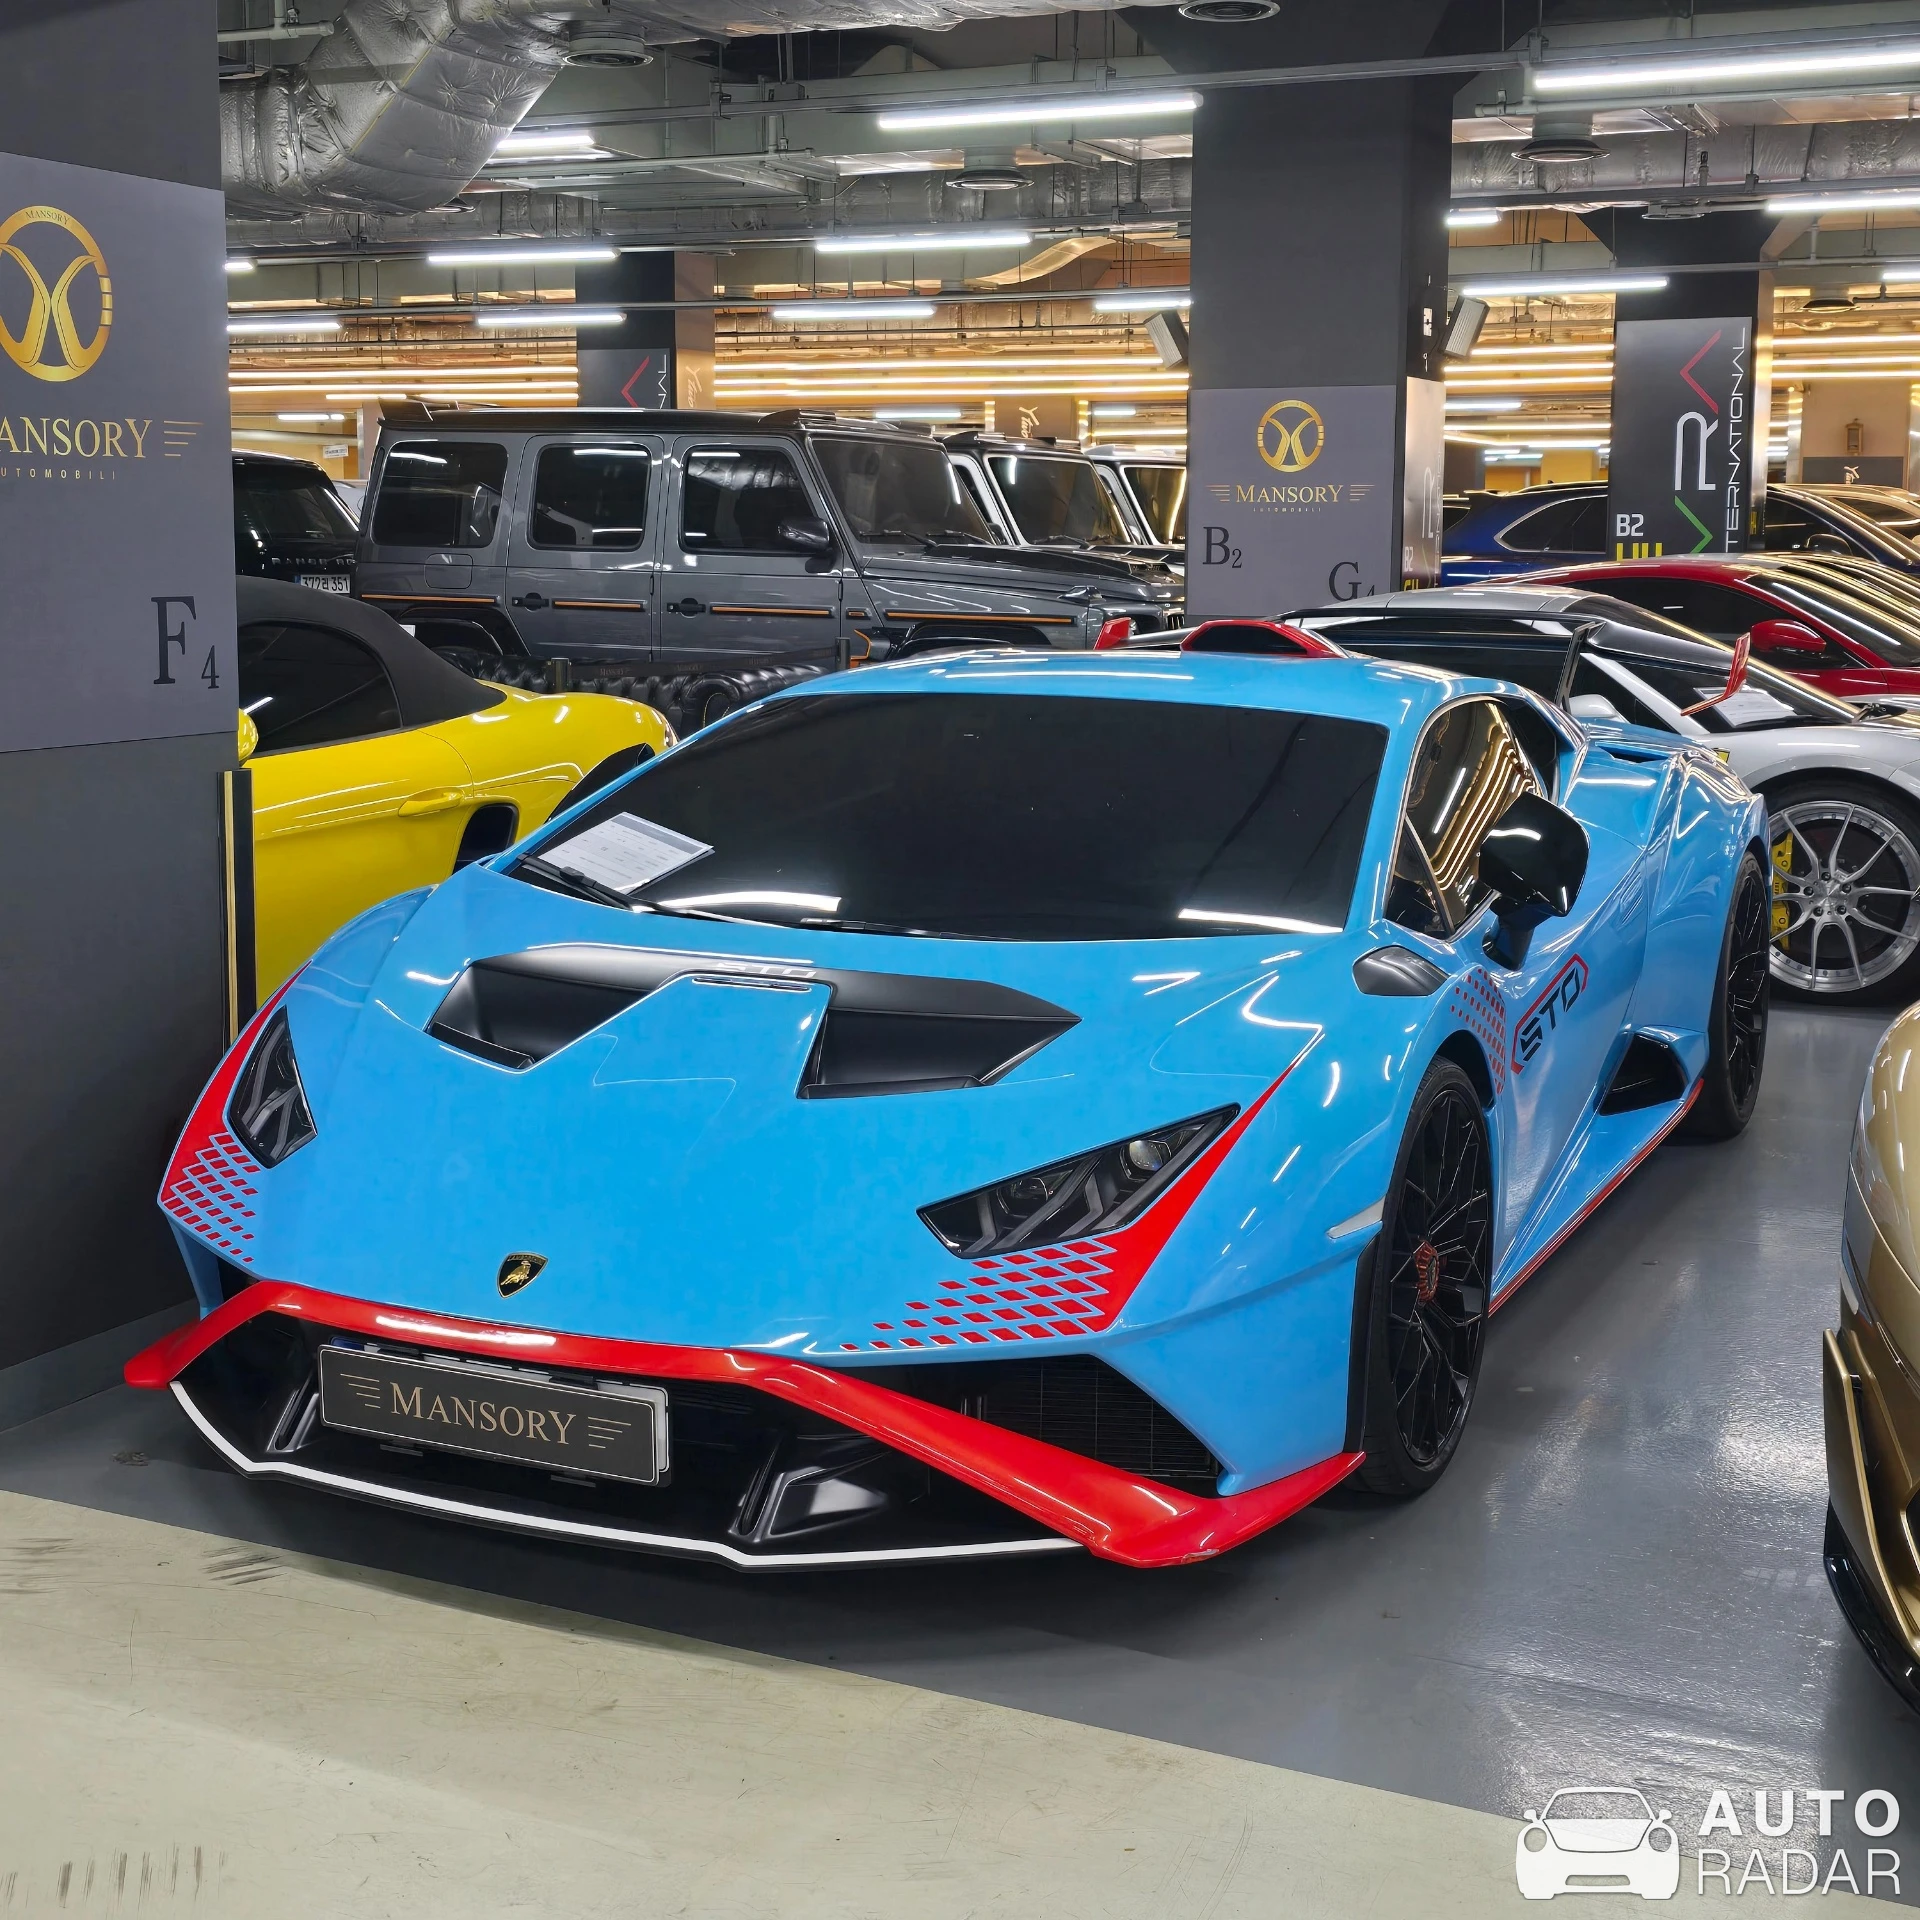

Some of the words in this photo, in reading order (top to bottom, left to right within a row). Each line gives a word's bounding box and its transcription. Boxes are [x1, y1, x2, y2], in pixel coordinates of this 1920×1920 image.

[25, 210, 70, 225] MANSORY
[0, 416, 153, 458] ANSORY
[1725, 327, 1746, 553] TERNATIONAL
[0, 467, 115, 481] UTOMOBILI
[1236, 484, 1344, 503] MANSORY
[1616, 513, 1645, 537] B2
[331, 576, 349, 592] 351
[1520, 967, 1581, 1062] STO
[390, 1382, 577, 1445] MANSORY
